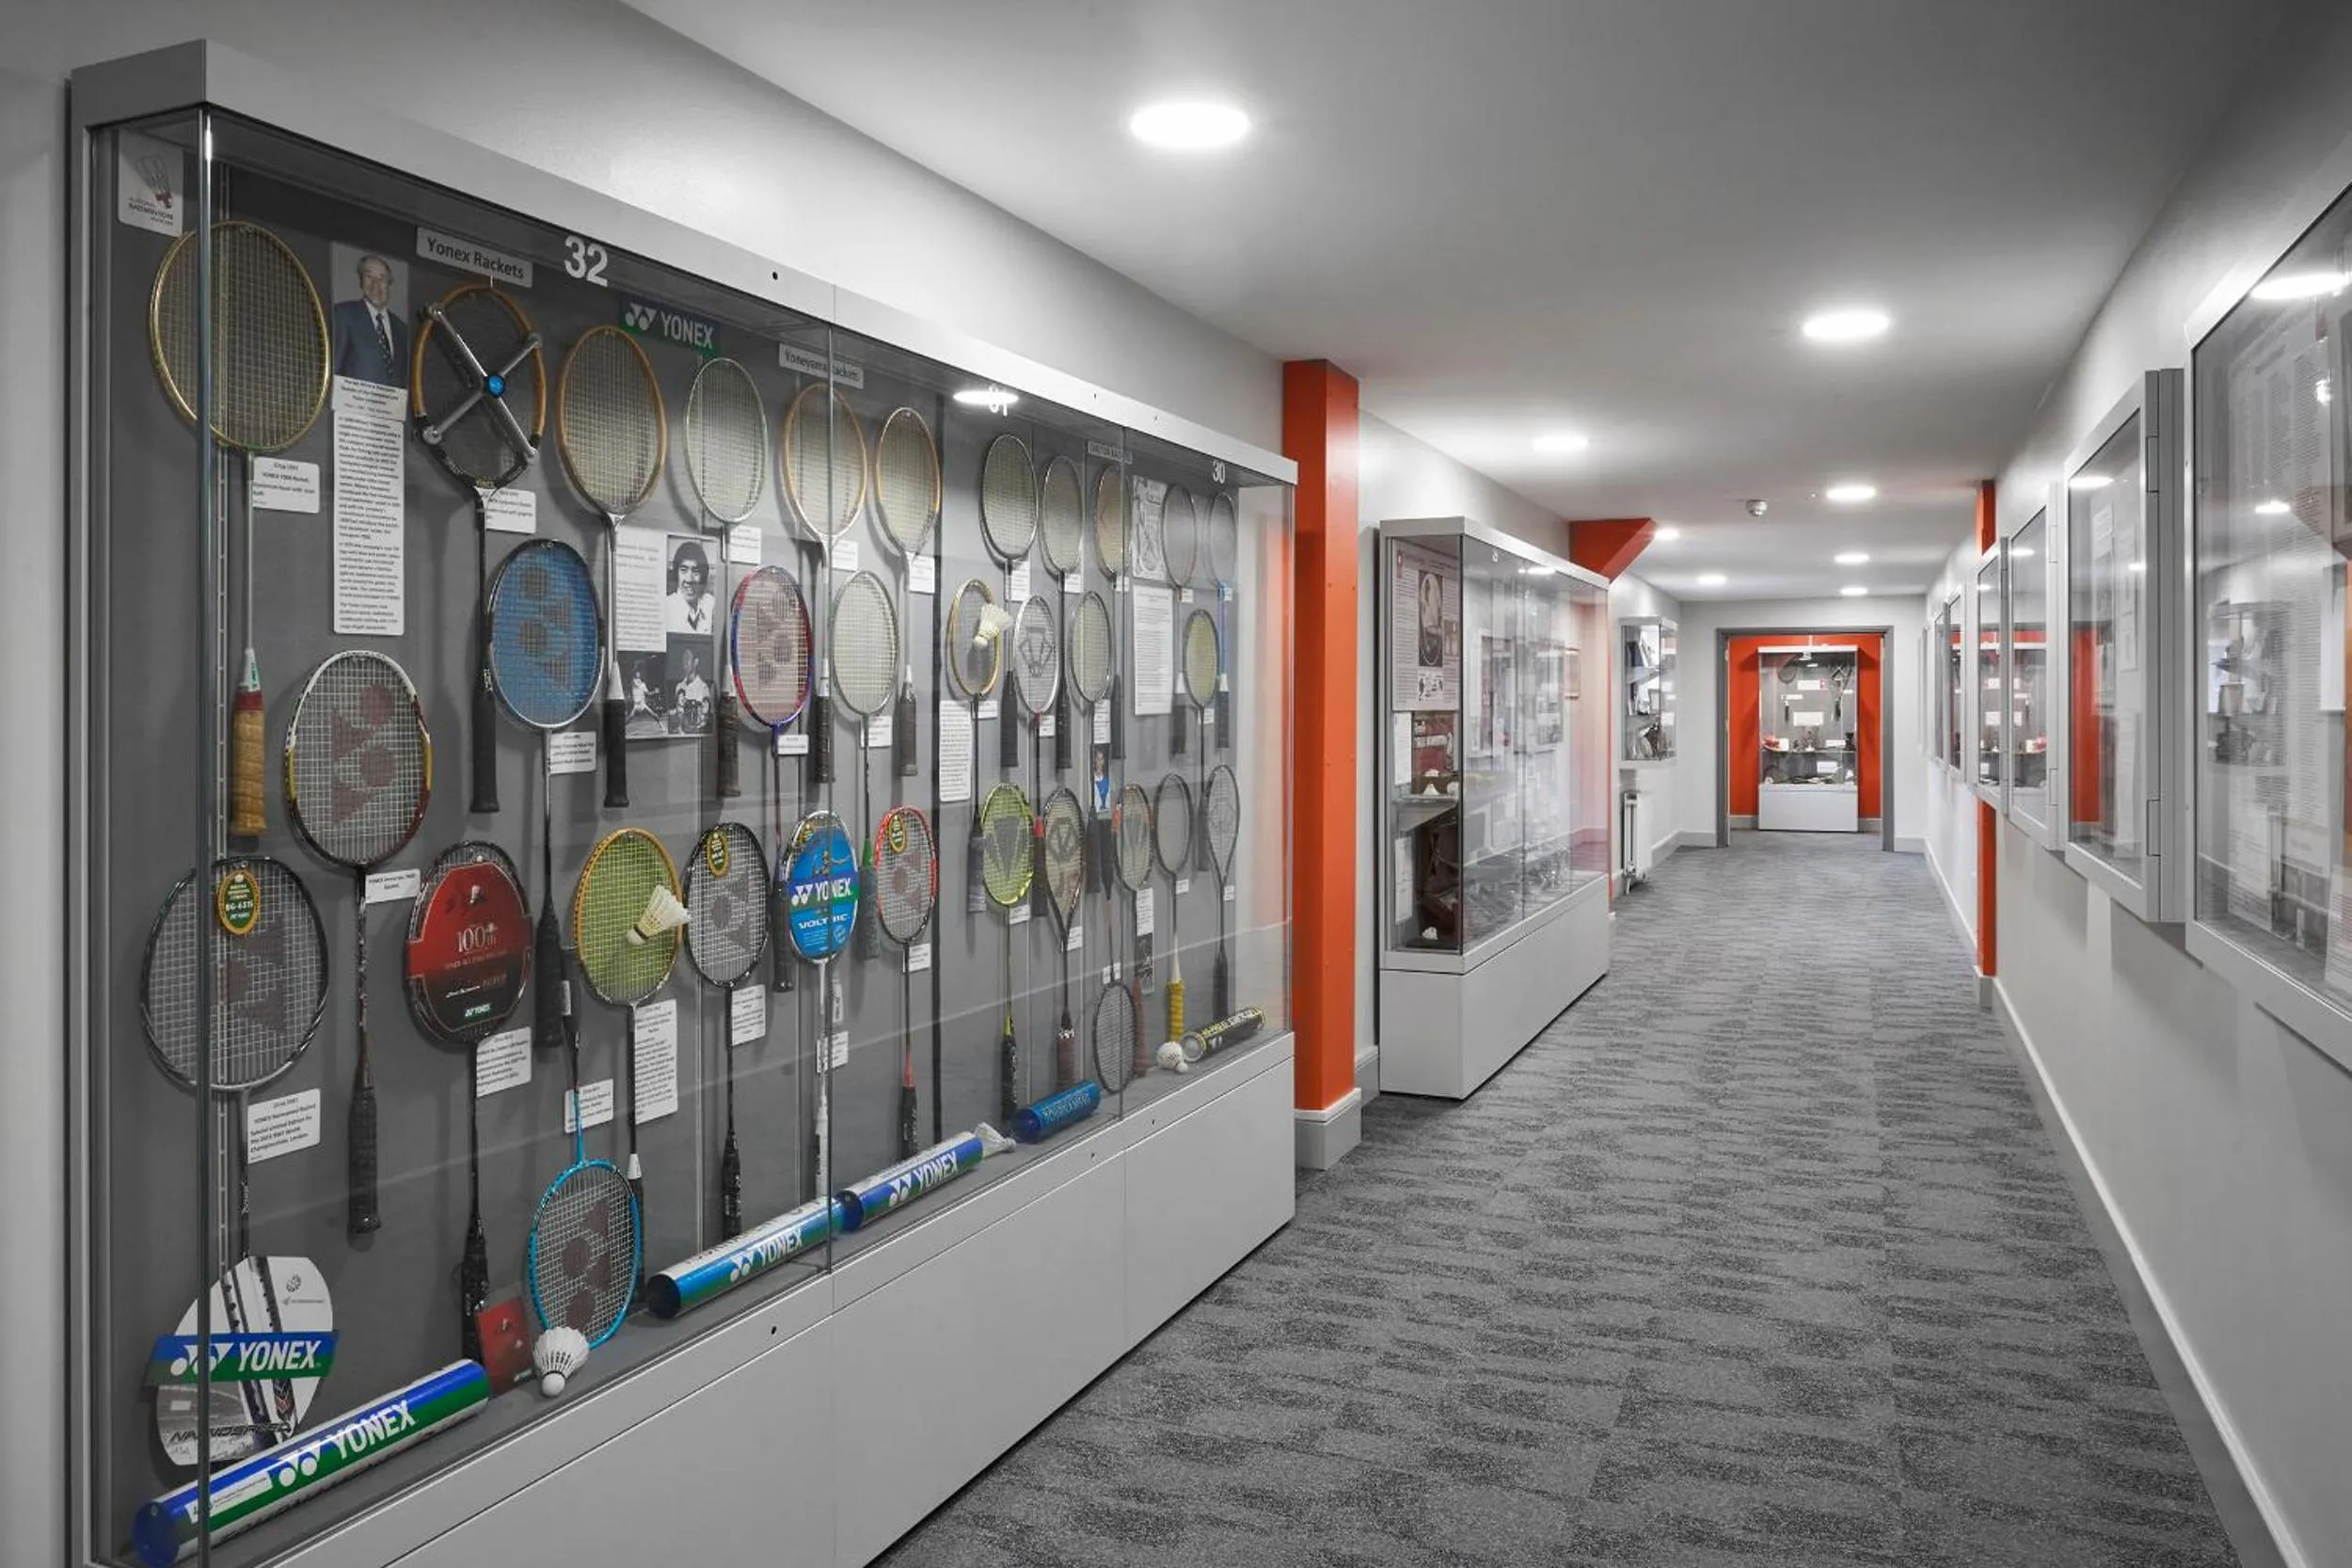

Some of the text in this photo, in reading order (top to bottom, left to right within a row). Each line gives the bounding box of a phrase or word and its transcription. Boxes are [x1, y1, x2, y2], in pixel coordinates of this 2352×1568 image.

[426, 236, 525, 279] Yonex Rackets
[564, 235, 608, 287] 32
[660, 309, 715, 349] YONEX
[1213, 460, 1226, 484] 30
[814, 878, 851, 903] YONEX
[798, 912, 850, 929] VOLTIC
[912, 1148, 959, 1194] YONEX
[756, 1227, 803, 1266] YONEX
[237, 1339, 323, 1372] YONEX
[329, 1400, 416, 1460] YONEX
